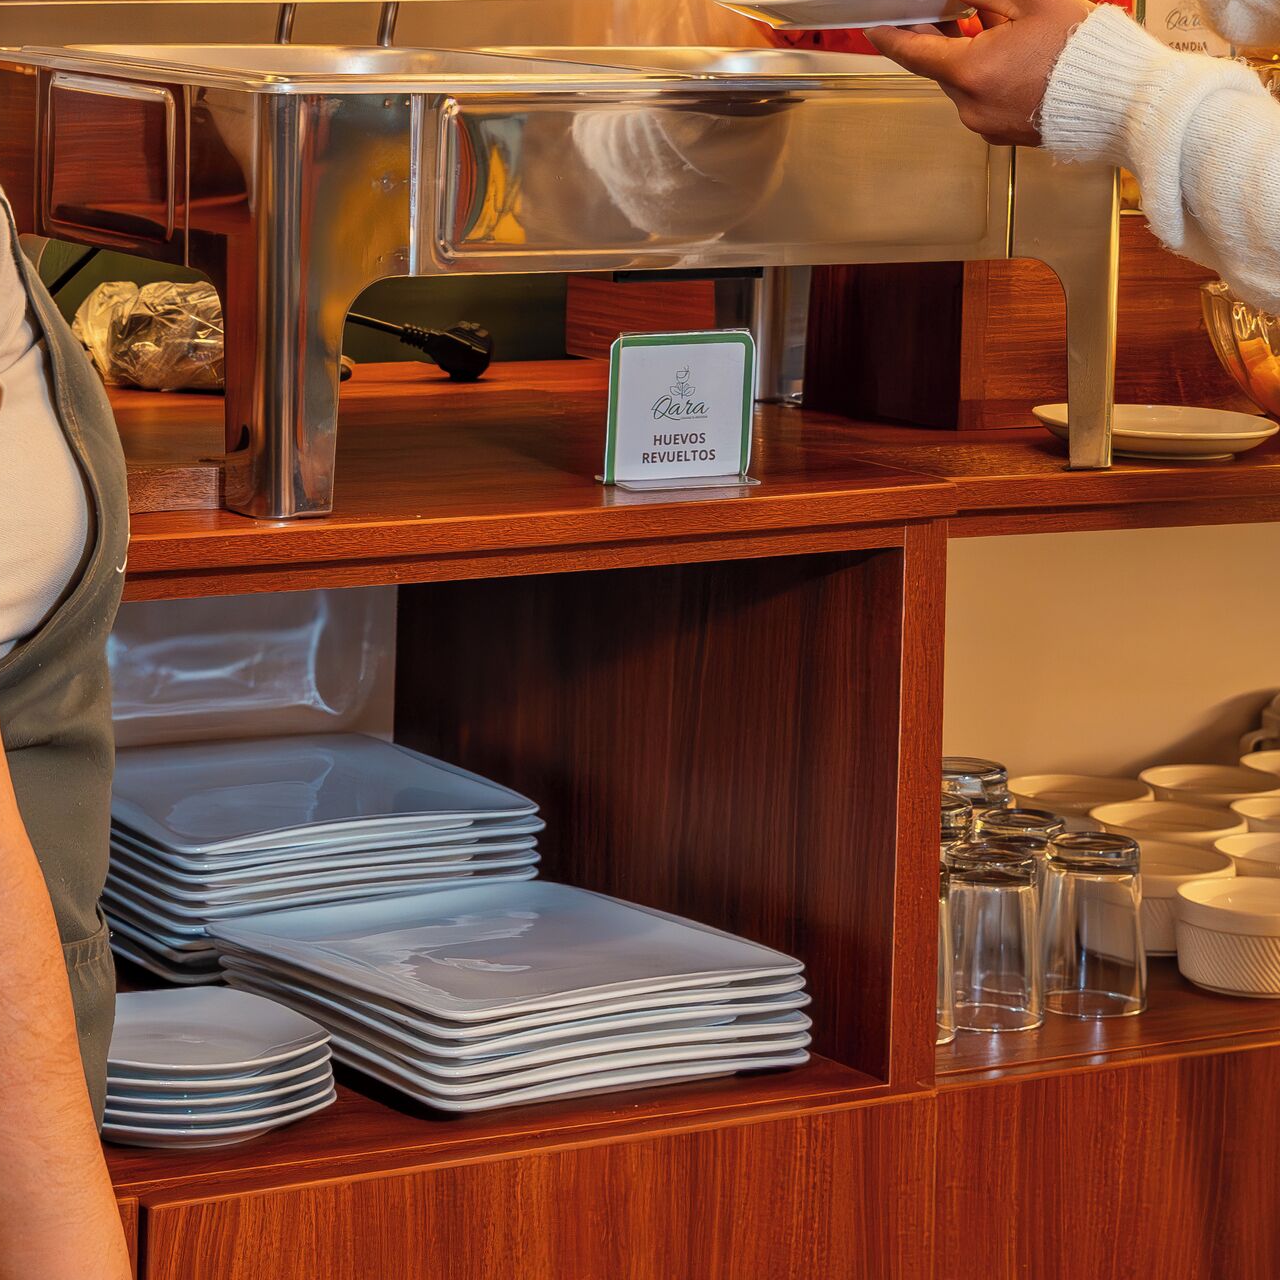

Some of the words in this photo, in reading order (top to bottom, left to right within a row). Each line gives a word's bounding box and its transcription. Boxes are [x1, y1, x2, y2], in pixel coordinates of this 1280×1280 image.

[651, 395, 710, 421] Qara
[653, 432, 706, 446] HUEVOS
[642, 449, 716, 464] REVUELTOS
